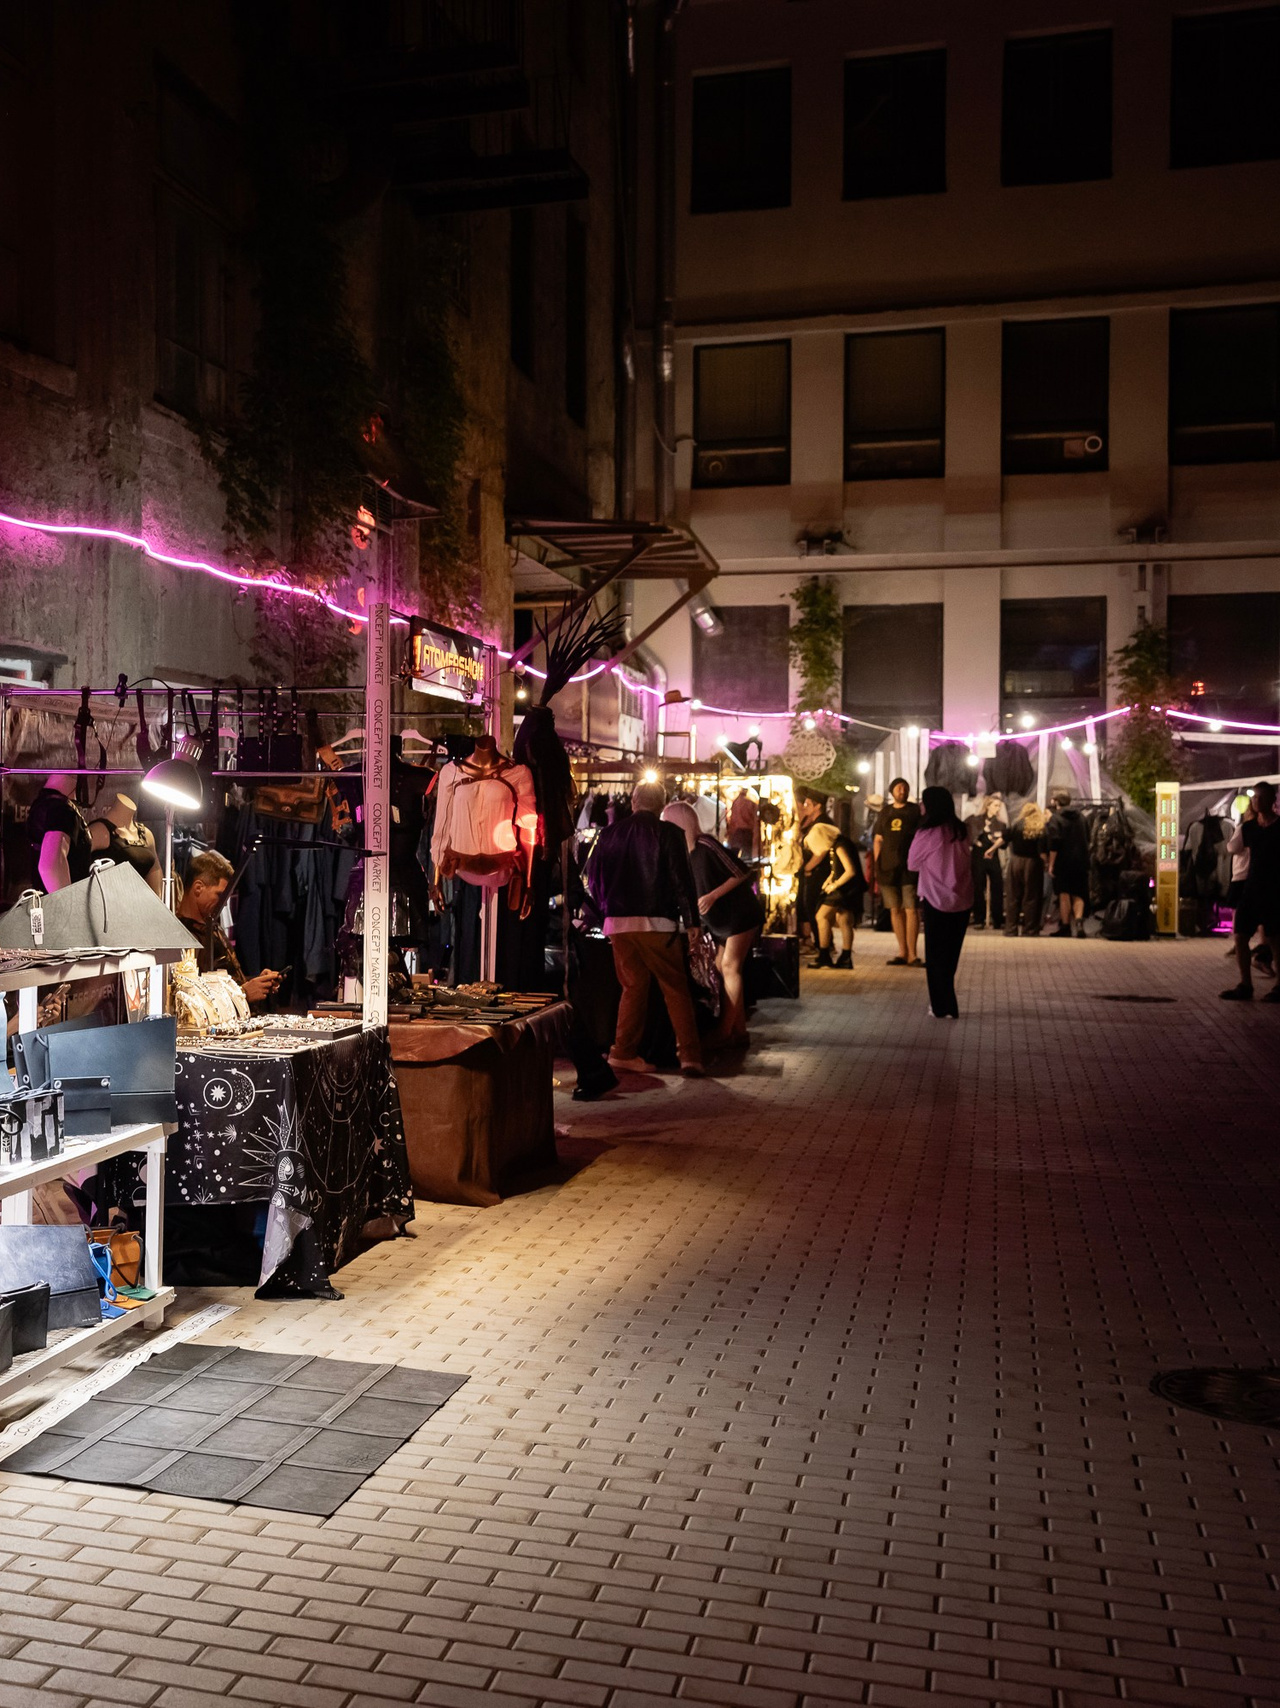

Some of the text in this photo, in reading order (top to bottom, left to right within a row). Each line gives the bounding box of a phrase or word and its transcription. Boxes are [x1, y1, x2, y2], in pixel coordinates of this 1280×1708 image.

[374, 645, 384, 686] MARKET
[373, 698, 384, 790] CONCEPT MARKET
[372, 802, 383, 850] CONCEPT
[370, 906, 381, 997] CONCEPT MARKET
